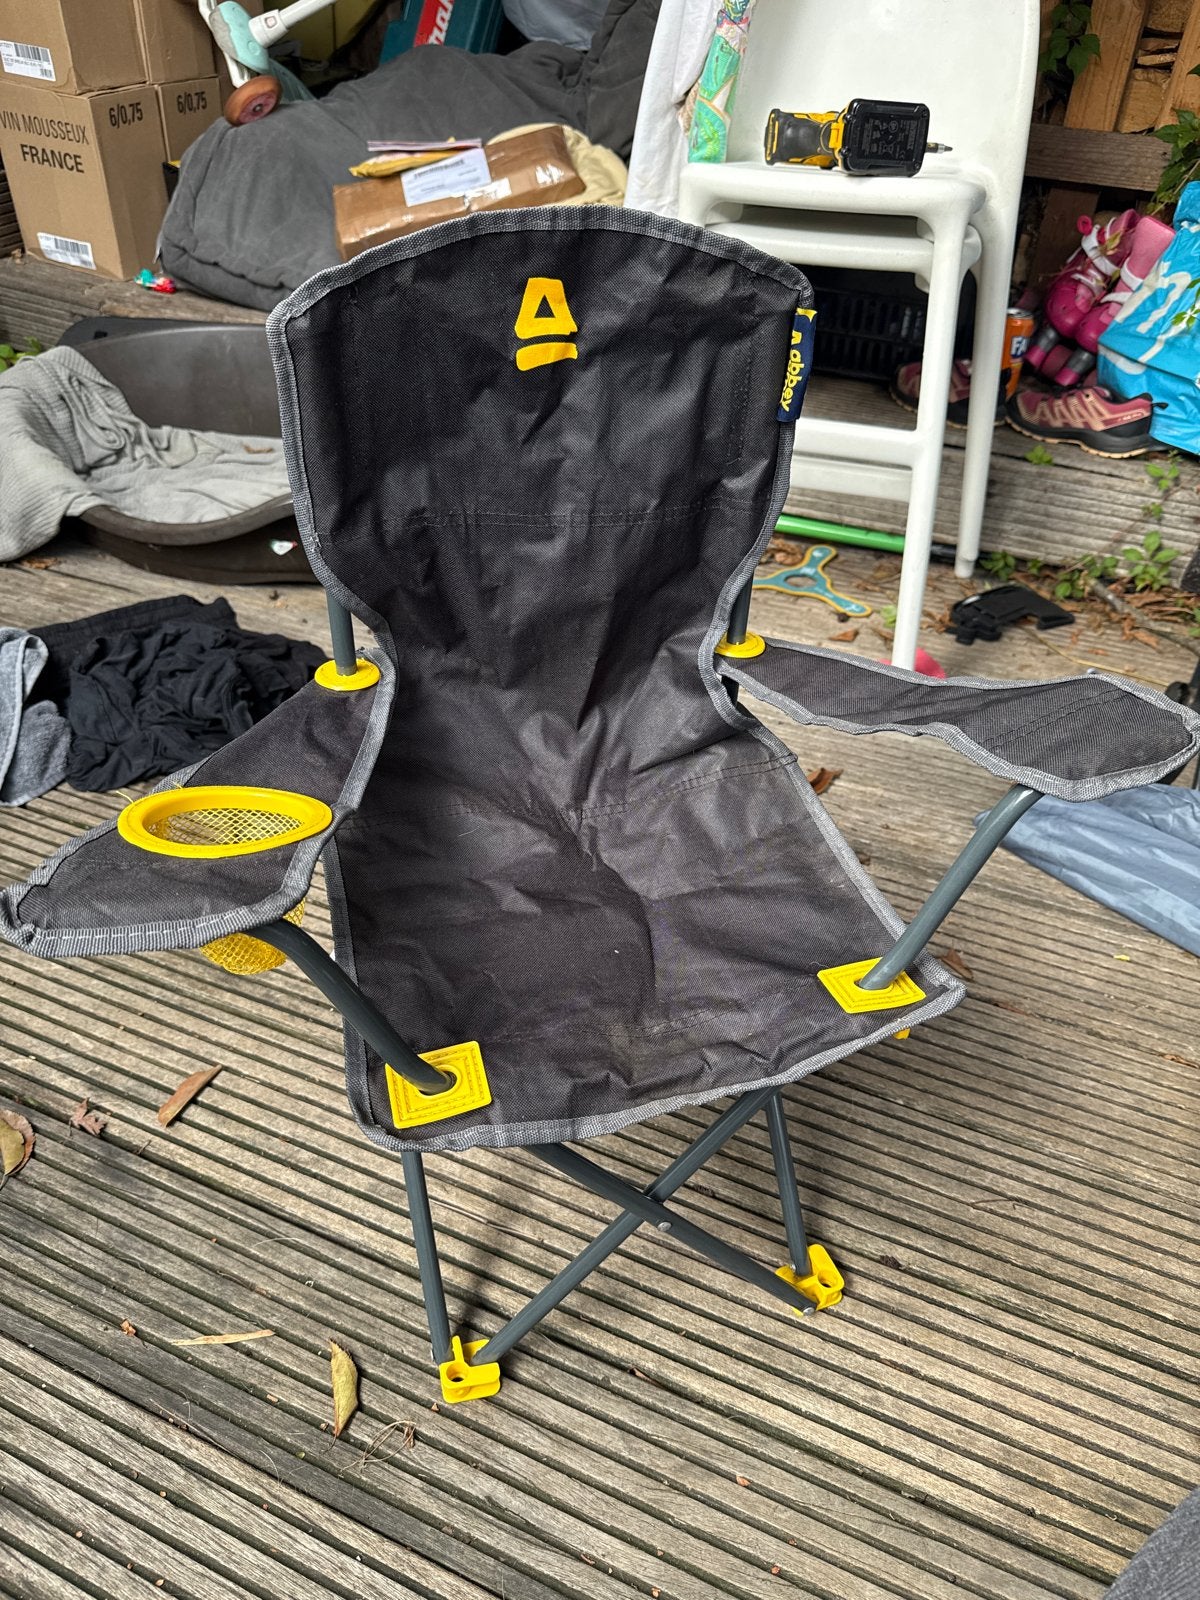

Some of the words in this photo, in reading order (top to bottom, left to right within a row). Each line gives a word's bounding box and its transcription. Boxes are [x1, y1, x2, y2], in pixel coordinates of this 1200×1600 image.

[108, 102, 144, 128] 6/0,75
[176, 91, 208, 114] 6/0,75
[0, 110, 21, 132] VIN
[21, 114, 89, 145] MOUSSEUX
[20, 143, 84, 173] FRANCE
[780, 349, 805, 412] abbey
